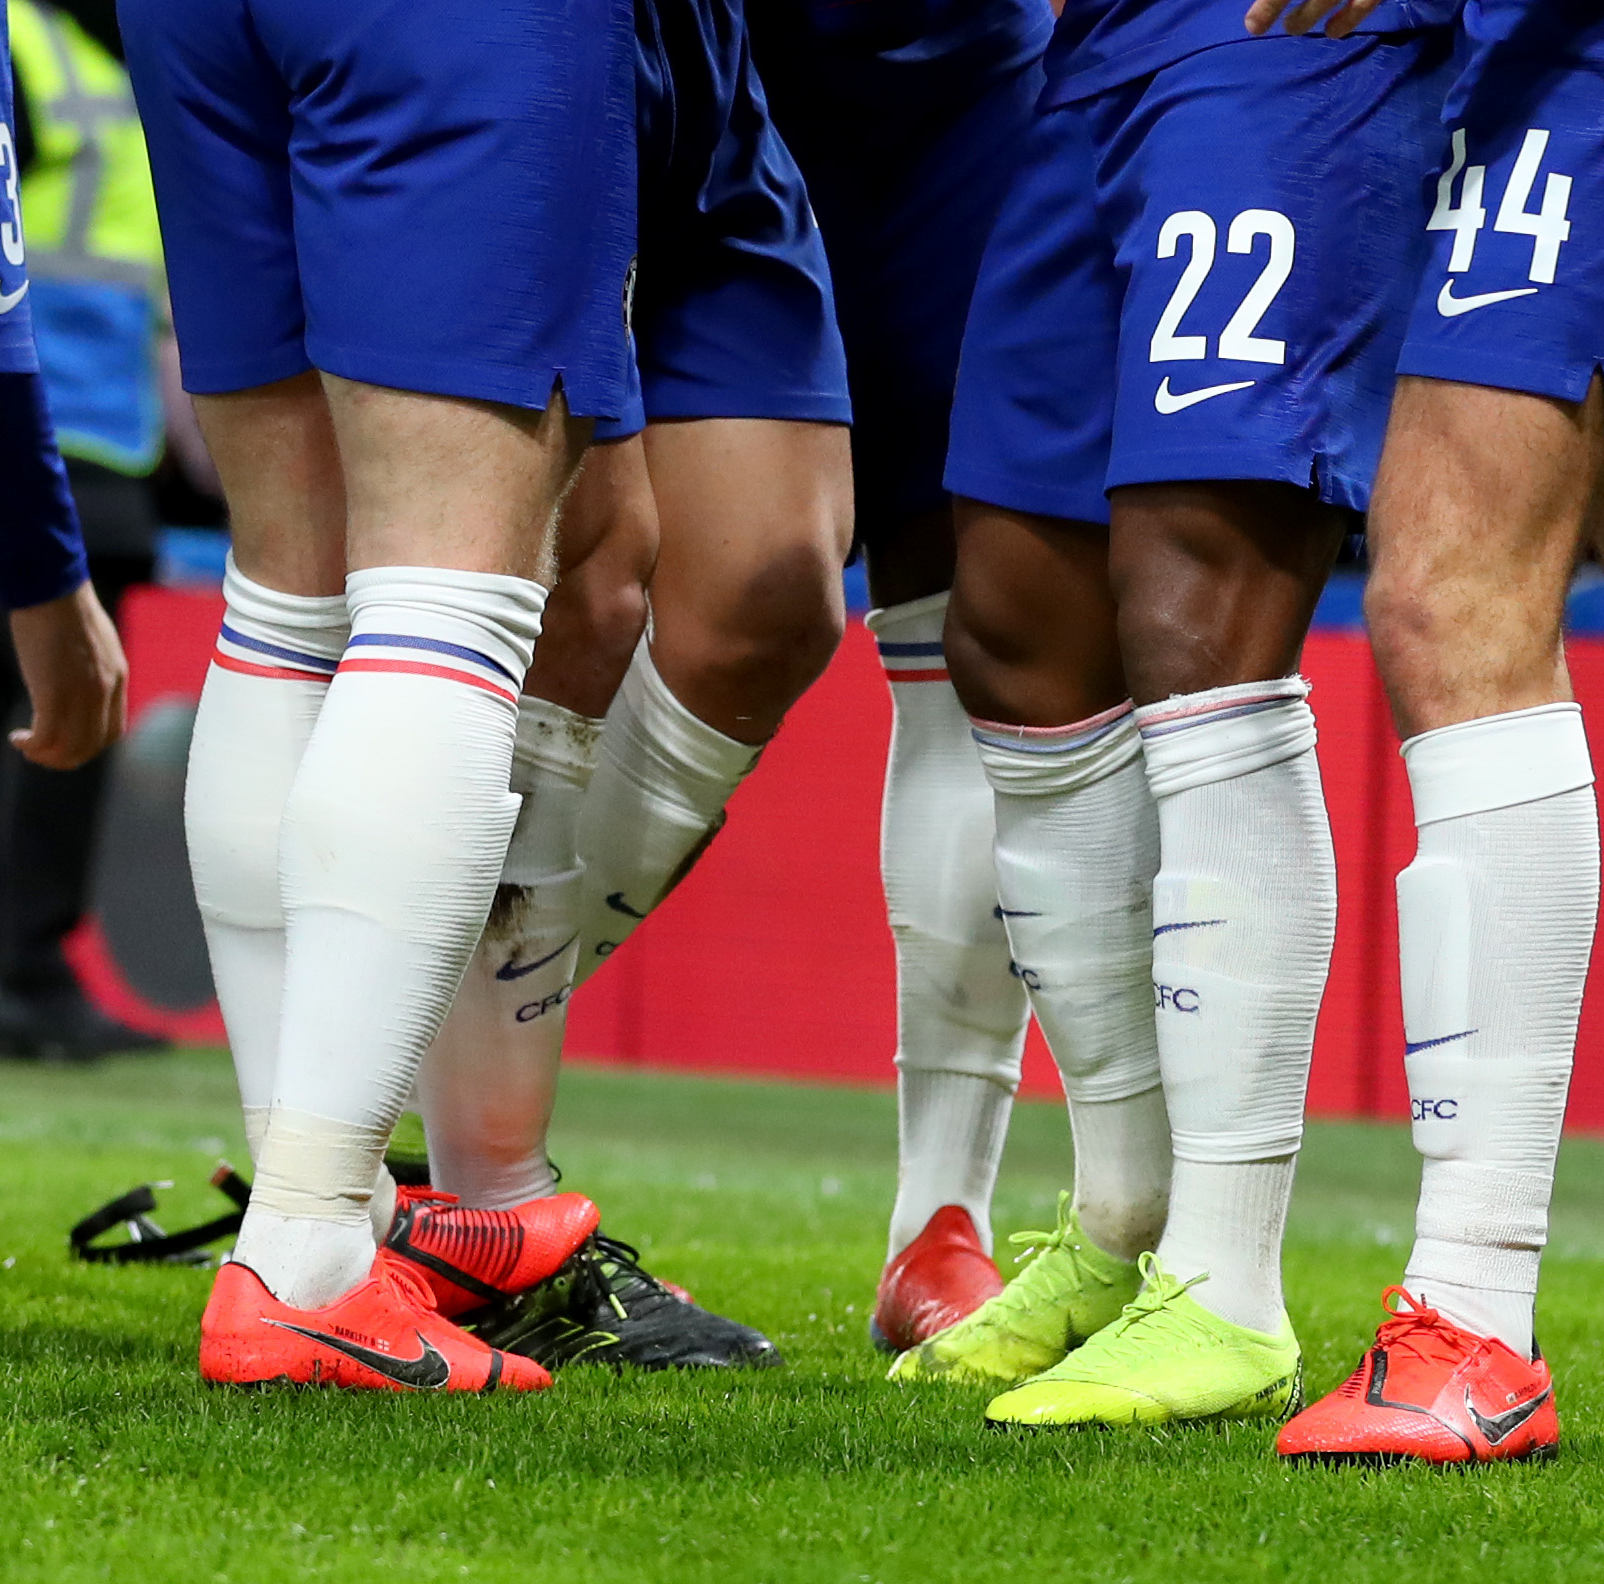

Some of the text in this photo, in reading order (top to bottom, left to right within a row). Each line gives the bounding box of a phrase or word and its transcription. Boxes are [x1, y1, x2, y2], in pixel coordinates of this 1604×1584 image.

[1425, 127, 1573, 284] 44
[1148, 209, 1296, 365] 22
[1410, 1098, 1458, 1121] CFC
